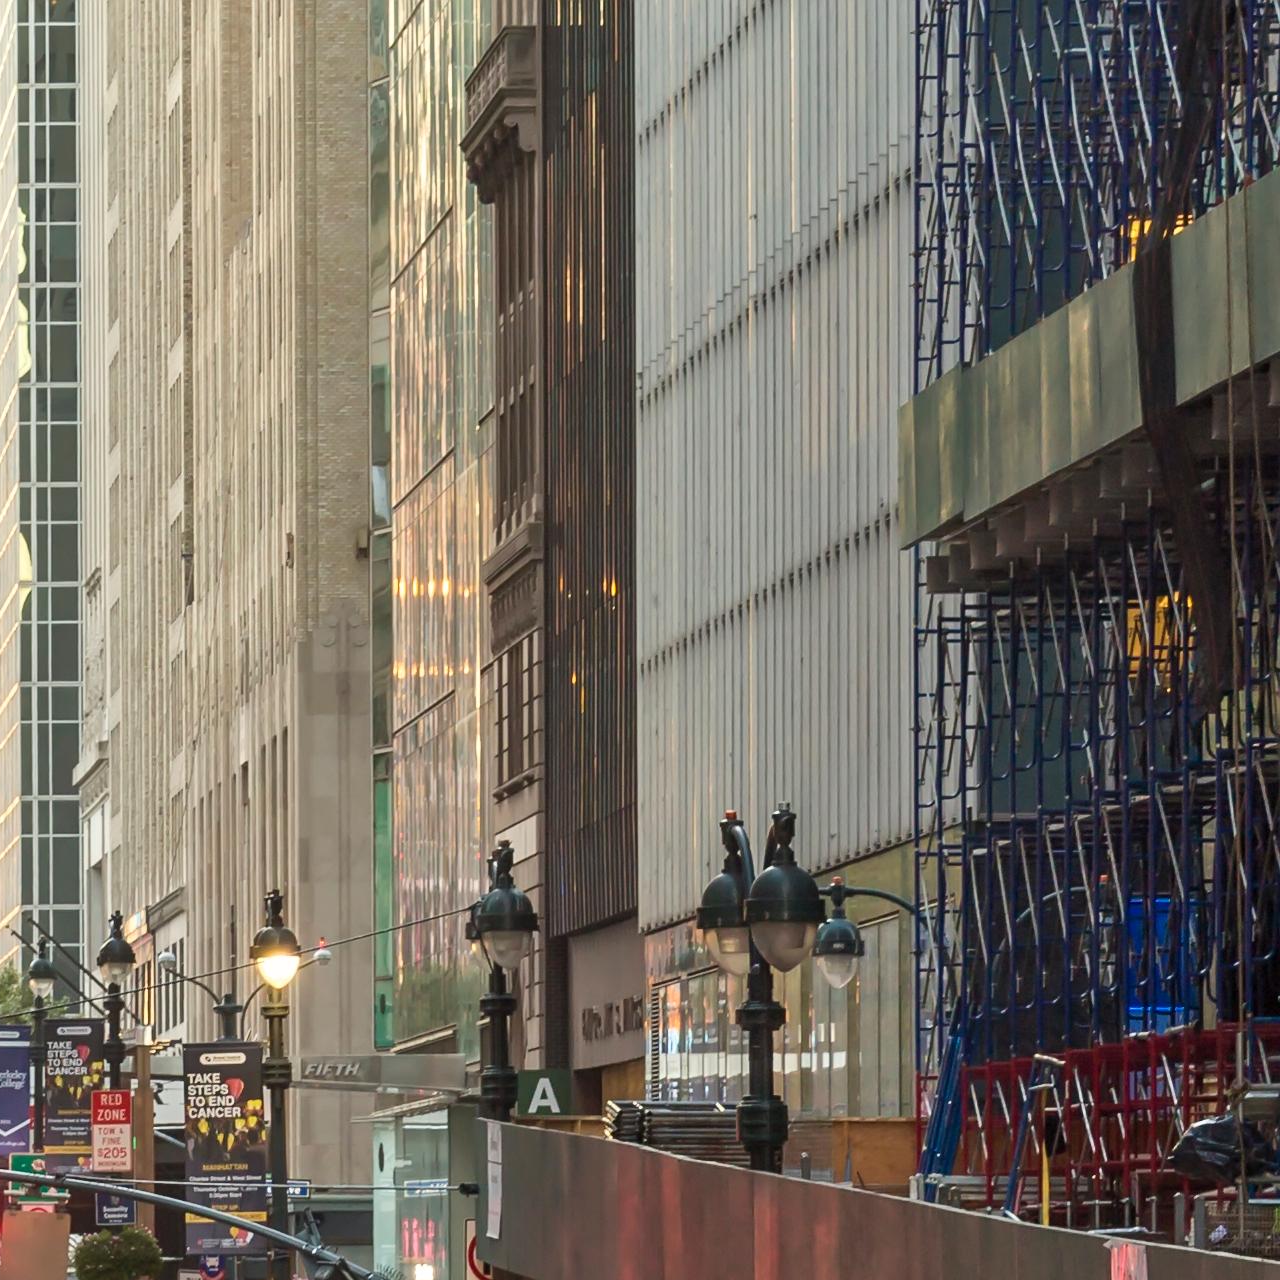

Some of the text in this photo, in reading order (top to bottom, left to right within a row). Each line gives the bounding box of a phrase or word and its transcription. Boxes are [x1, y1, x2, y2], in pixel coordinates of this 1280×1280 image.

[47, 1041, 73, 1050] TAKE
[47, 1050, 78, 1058] STEPS
[47, 1066, 88, 1076] CANCER
[304, 1062, 361, 1076] FIFTH
[187, 1072, 220, 1084] TAKE
[188, 1084, 229, 1096] STEPS
[528, 1077, 561, 1114] A
[100, 1094, 122, 1106] RED
[188, 1096, 235, 1107] TO END
[98, 1109, 126, 1121] ZONE
[189, 1106, 242, 1118] CANCER
[98, 1128, 116, 1136] TOW
[98, 1148, 128, 1159] $205
